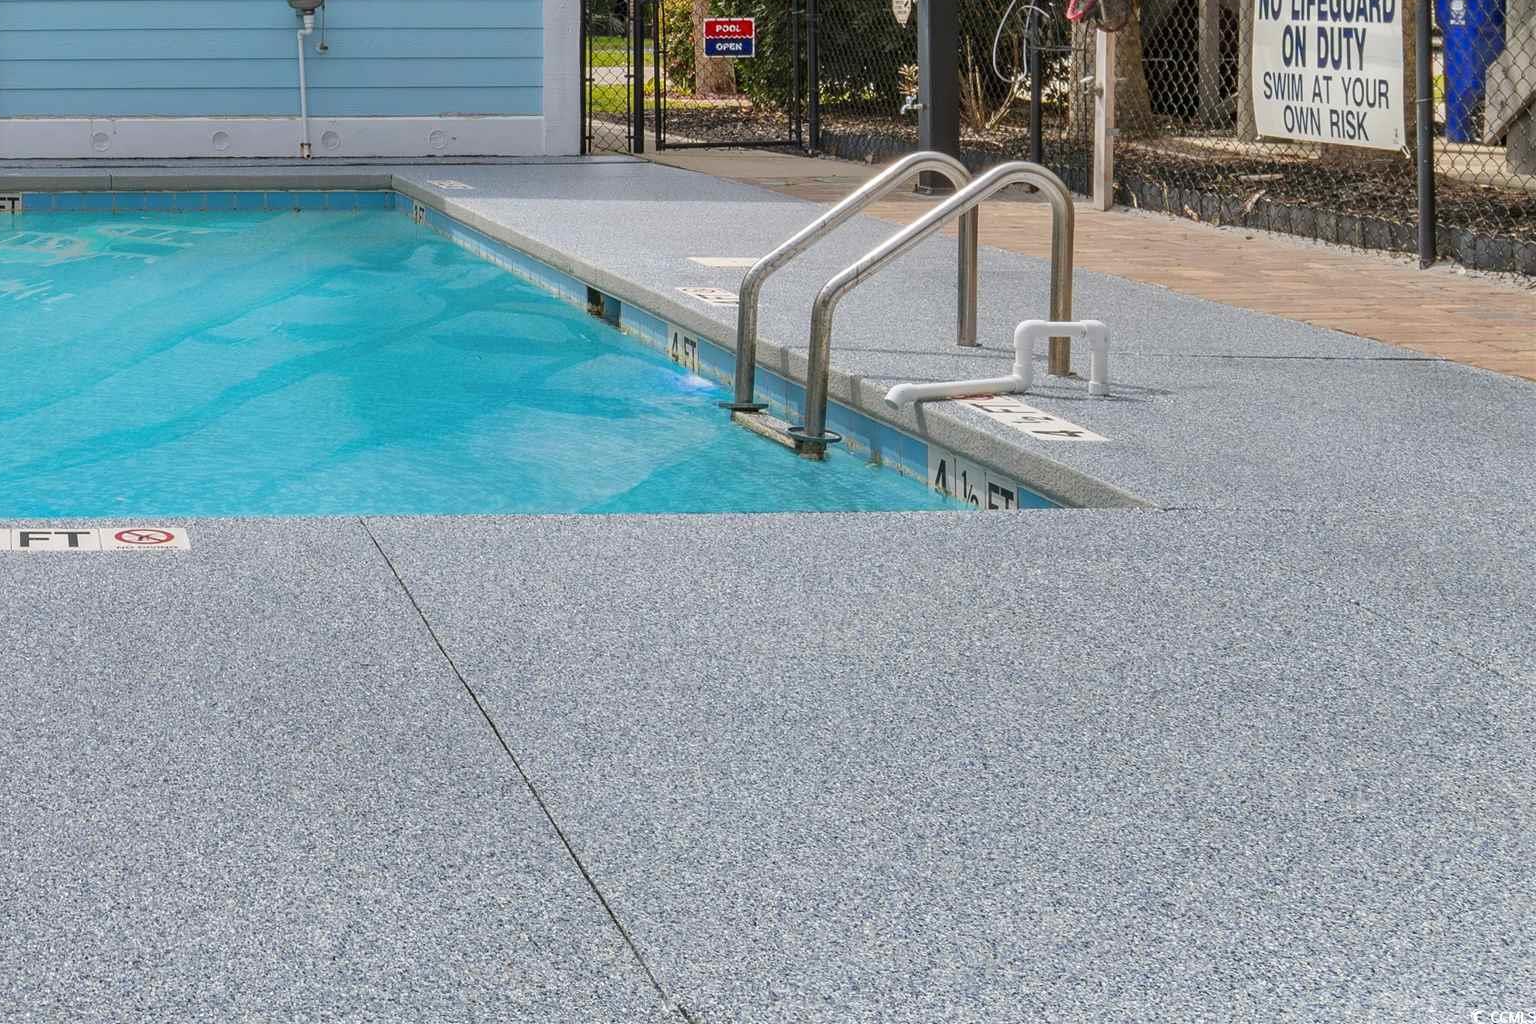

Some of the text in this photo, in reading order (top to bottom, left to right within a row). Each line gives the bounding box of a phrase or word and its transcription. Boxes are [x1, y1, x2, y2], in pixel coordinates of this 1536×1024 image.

[715, 24, 741, 32] POOL
[716, 42, 743, 50] OPEN
[1282, 25, 1366, 71] ON DUTY
[1264, 71, 1389, 109] SWIM AT YOUR
[1283, 105, 1321, 136] OWN
[1329, 109, 1369, 141] RISK
[988, 481, 1014, 510] FT
[19, 531, 91, 548] FT
